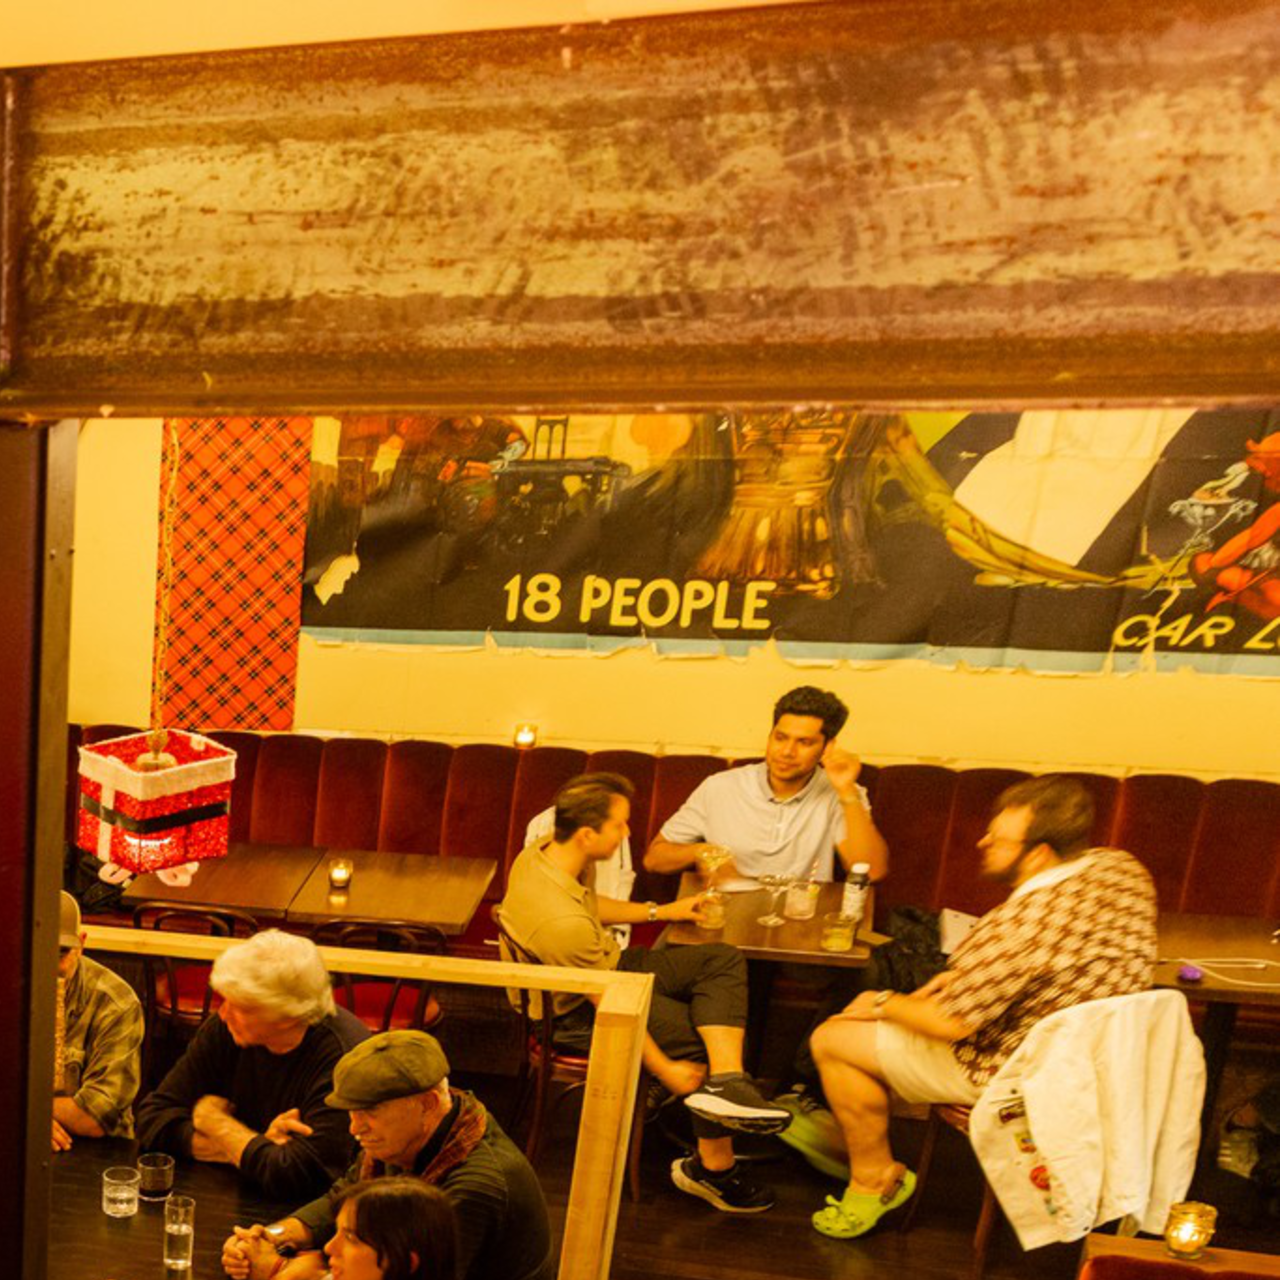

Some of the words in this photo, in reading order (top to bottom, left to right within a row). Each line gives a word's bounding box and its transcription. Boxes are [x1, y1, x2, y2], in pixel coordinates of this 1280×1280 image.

[504, 573, 562, 623] 18
[579, 574, 777, 630] PEOPLE
[1112, 614, 1235, 648] CAR
